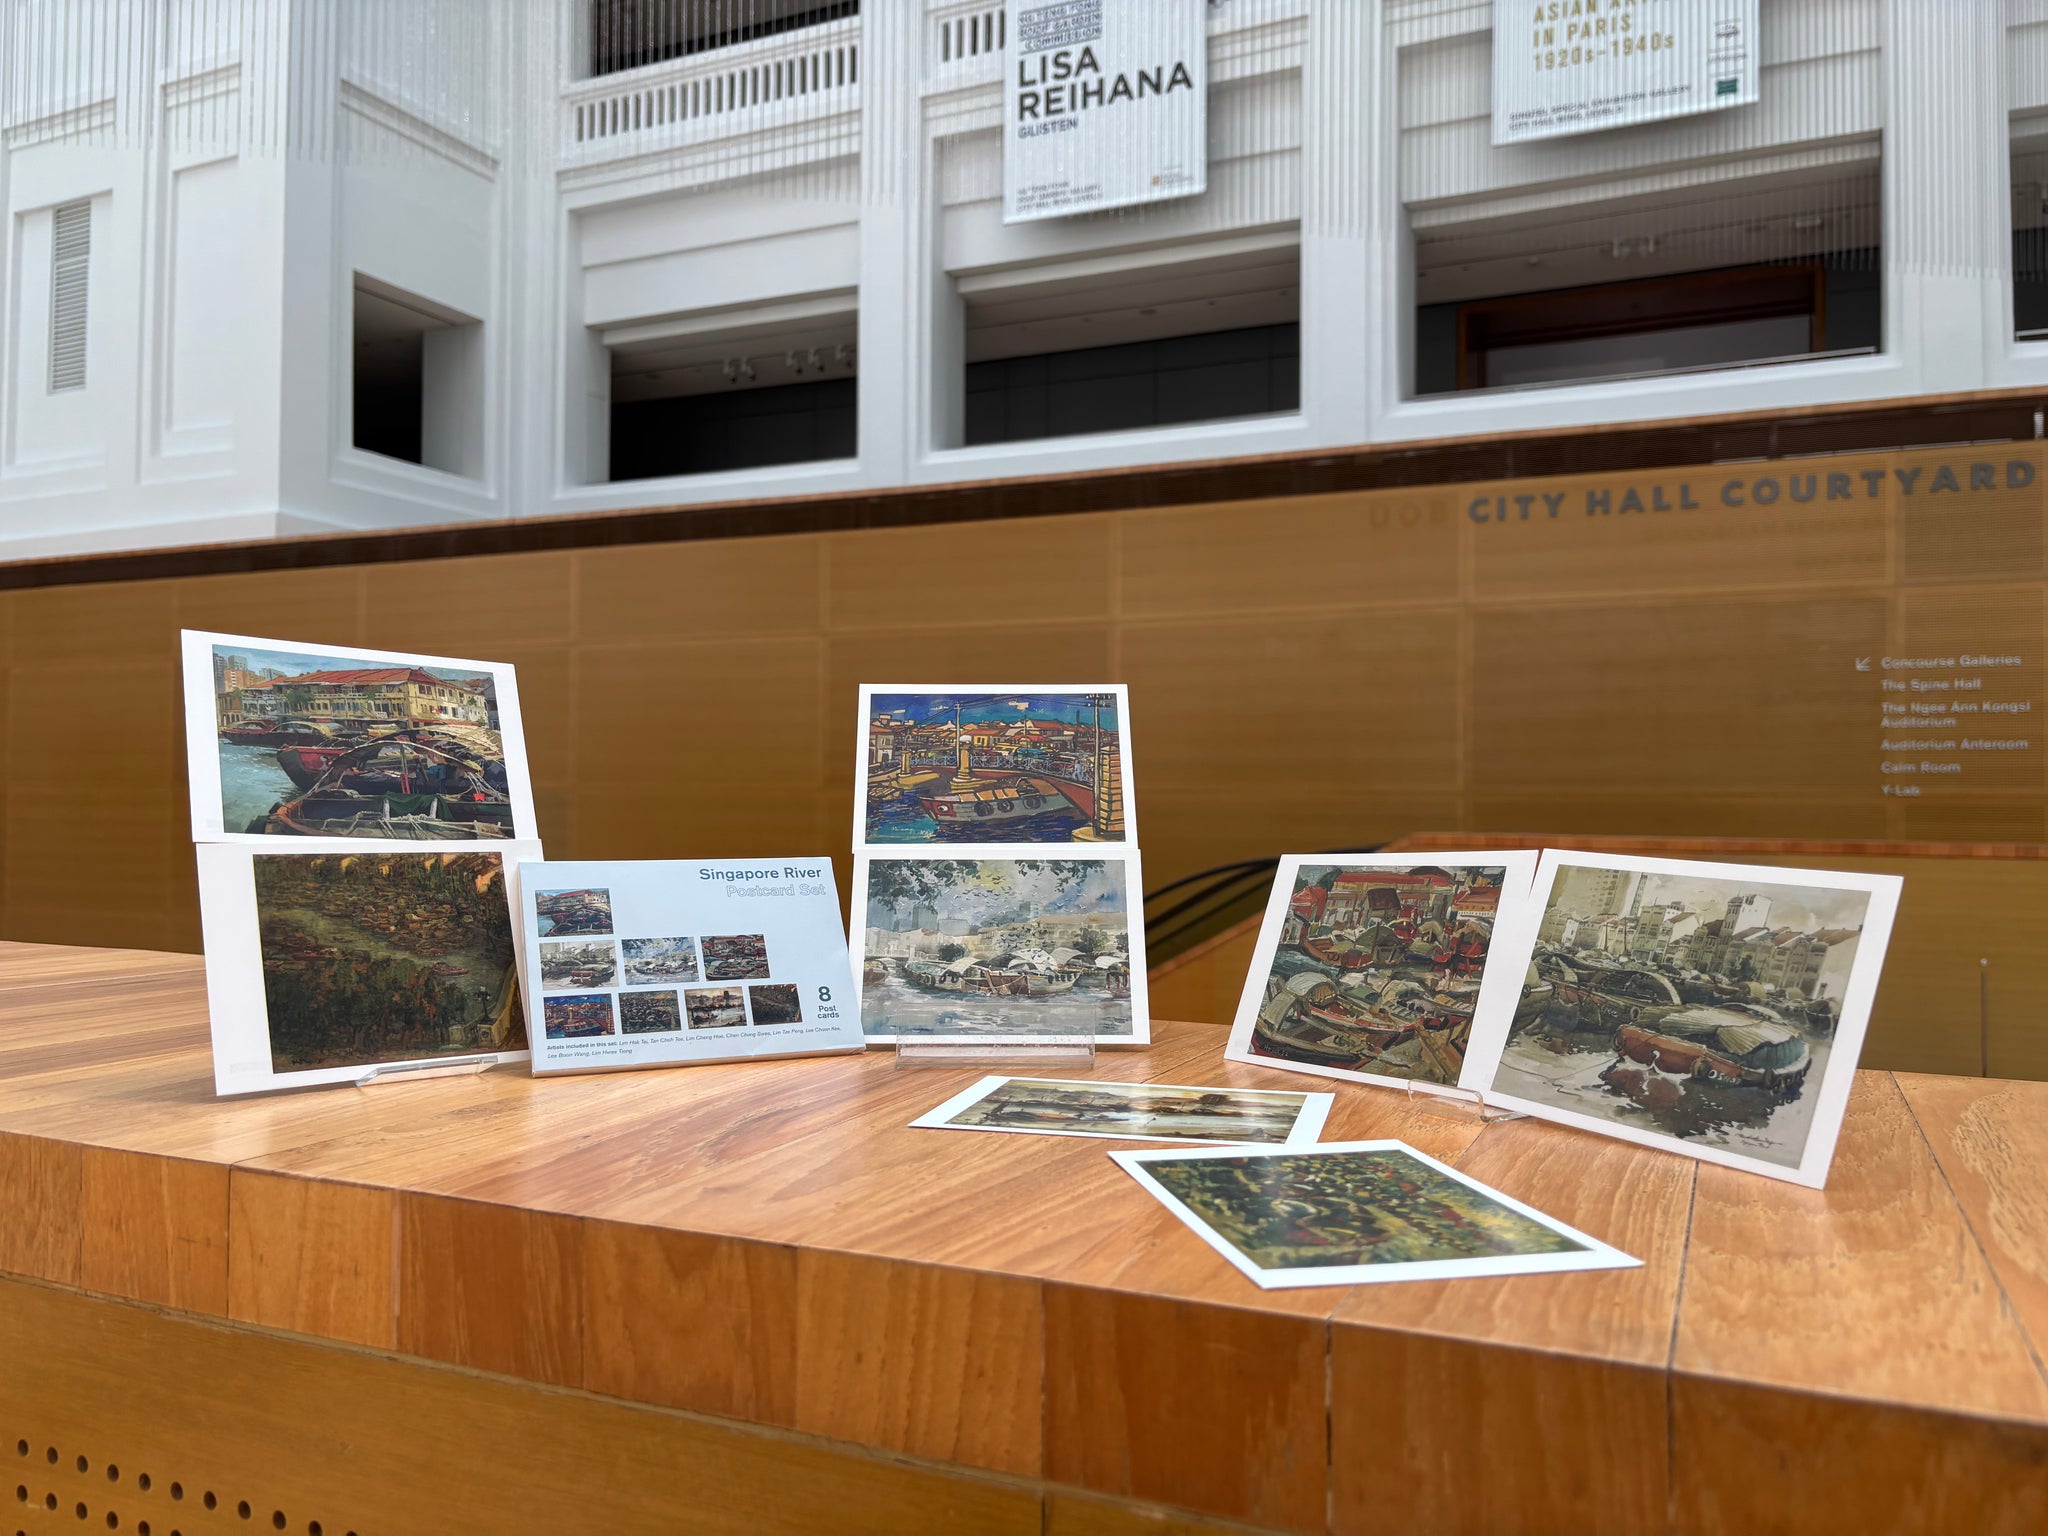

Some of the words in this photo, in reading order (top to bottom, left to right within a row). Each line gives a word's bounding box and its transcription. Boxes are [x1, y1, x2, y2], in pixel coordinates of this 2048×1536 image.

[1534, 0, 1596, 24] ASIAN
[1534, 27, 1555, 48] IN
[1567, 14, 1632, 42] PARIS
[1019, 47, 1099, 87] LISA
[1019, 62, 1193, 121] REIHANA
[1468, 492, 1566, 523] CITY
[1585, 484, 1701, 517] HALL
[1720, 461, 2036, 507] COURTYARD
[1880, 656, 1955, 669] Concourse
[1960, 654, 2022, 667] Galleries
[1881, 679, 1906, 691] The
[1911, 678, 1949, 692] Spine
[1954, 677, 1981, 689] Hall
[1881, 702, 1906, 714] The
[1911, 702, 1947, 716] Ngee
[1951, 701, 1978, 712] Ann
[1982, 700, 2031, 714] Kongsi
[1880, 716, 1957, 728] Auditorium
[1880, 738, 1956, 751] Auditorium
[1961, 738, 2029, 750] Anteroom
[1881, 761, 1916, 774] Calm
[1921, 761, 1961, 773] Room
[1881, 784, 1920, 796] Y-Lab
[699, 867, 779, 881] Singapore
[783, 866, 822, 878] River
[726, 884, 796, 898] Postcard
[799, 882, 827, 896] Set
[818, 986, 831, 1002] 8
